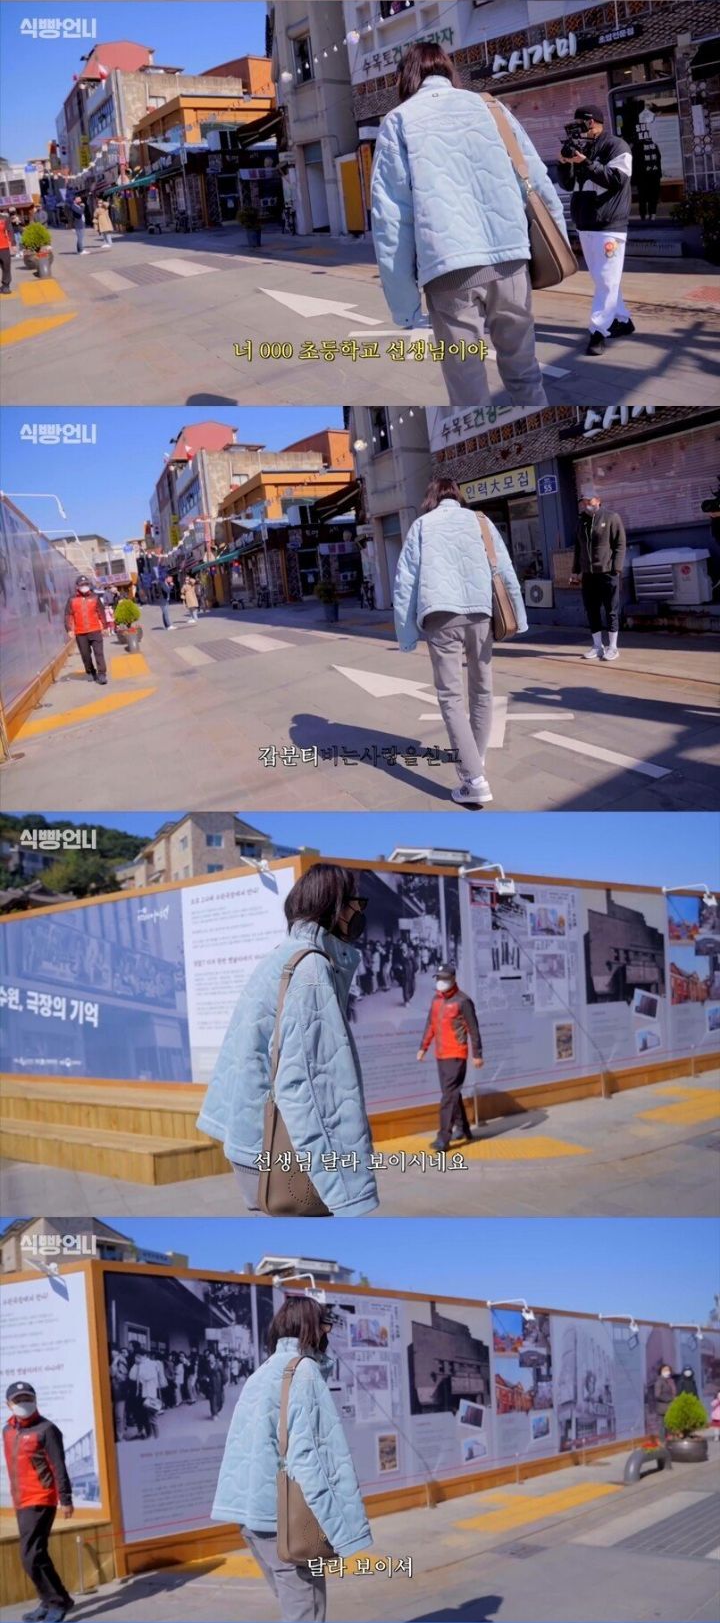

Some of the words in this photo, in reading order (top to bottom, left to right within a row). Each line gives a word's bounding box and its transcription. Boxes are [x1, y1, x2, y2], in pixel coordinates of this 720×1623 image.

[492, 32, 577, 78] 스시가미
[465, 471, 529, 500] 인력大모집
[26, 990, 66, 1021] 극장의
[70, 999, 99, 1028] 기억
